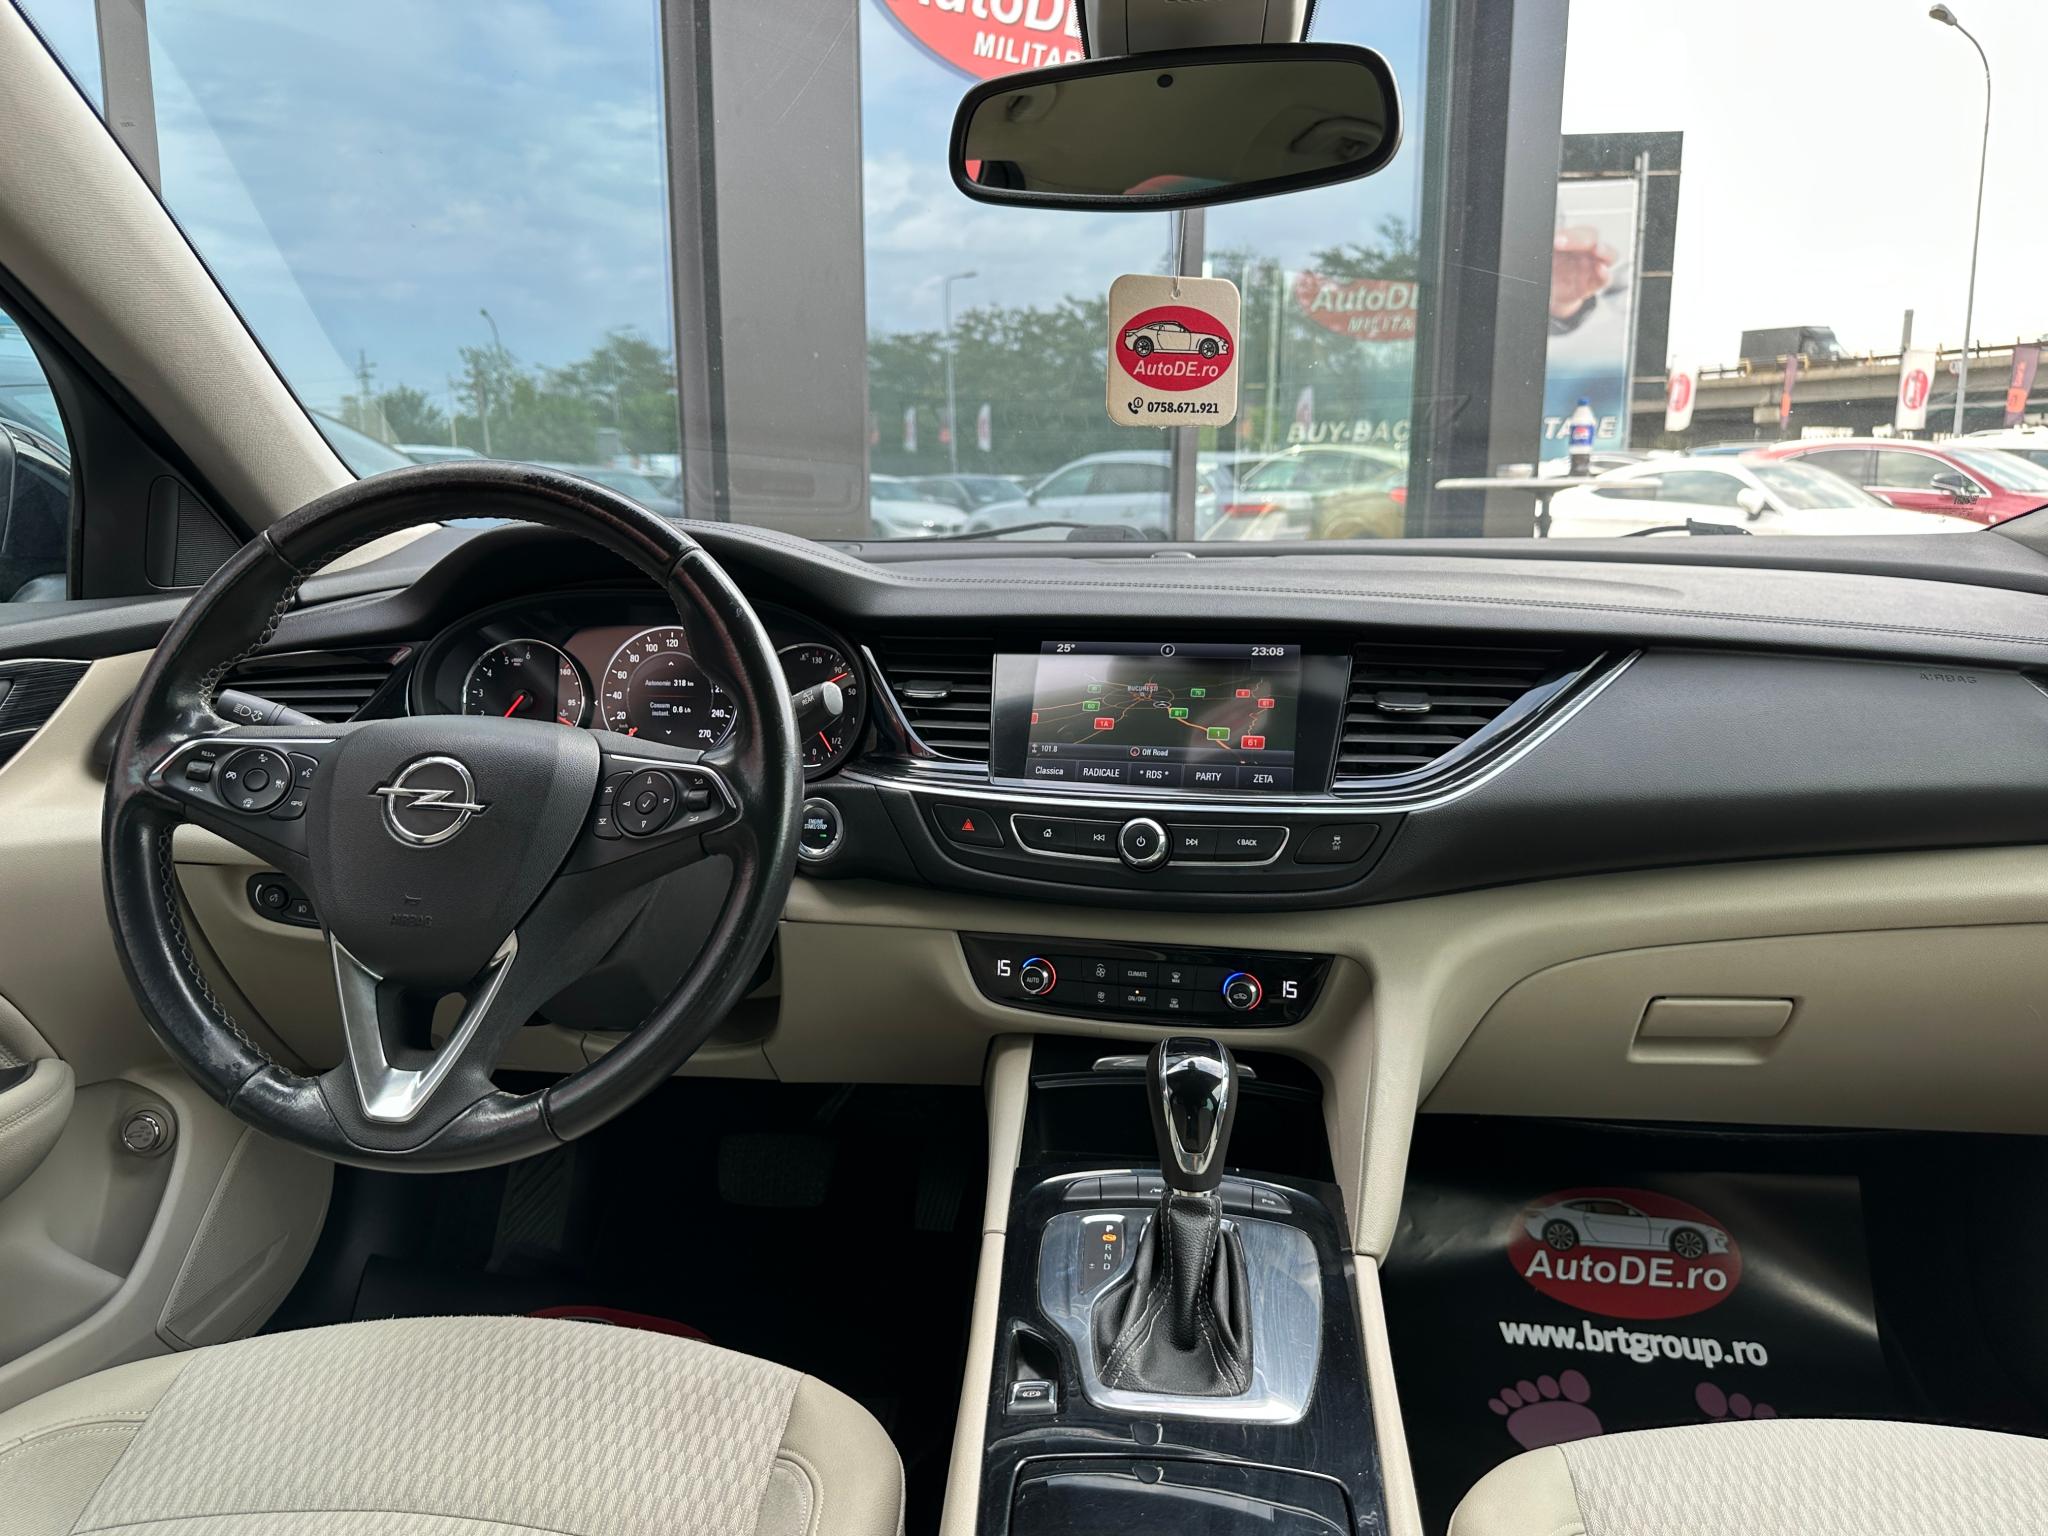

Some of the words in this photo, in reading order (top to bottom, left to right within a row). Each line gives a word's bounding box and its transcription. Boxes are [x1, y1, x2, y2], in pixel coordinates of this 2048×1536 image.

[1133, 360, 1219, 377] AutoDE.ro
[1147, 402, 1219, 413] 0758.671.921
[645, 644, 658, 652] 100
[1251, 647, 1284, 656] 23:08
[504, 656, 509, 665] 5
[525, 652, 531, 660] 6
[629, 655, 640, 663] 80
[617, 671, 627, 679] 60
[478, 689, 484, 697] 3
[612, 692, 622, 700] 40
[567, 698, 576, 706] 95
[616, 711, 626, 720] 20
[711, 709, 724, 718] 240
[698, 730, 711, 738] 270
[831, 737, 842, 745] 1/2
[1041, 744, 1058, 753] 101.8
[1142, 748, 1151, 756] Off
[1153, 749, 1169, 757] Road
[1035, 766, 1064, 775] Classica
[1083, 768, 1120, 777] RADICALE
[1195, 772, 1222, 781] PARTY
[1253, 774, 1274, 783] ZETA
[1241, 838, 1257, 846] BACK
[997, 959, 1012, 977] 15
[1127, 970, 1148, 978] CLIMATE
[1282, 980, 1298, 999] 15
[1106, 1224, 1114, 1233] P
[1104, 1243, 1112, 1251] R
[1103, 1253, 1112, 1261] N
[1103, 1262, 1111, 1270] D
[1525, 1250, 1728, 1291] AutoDE.ro
[1499, 1320, 1768, 1368] www.brtgroup.ro
